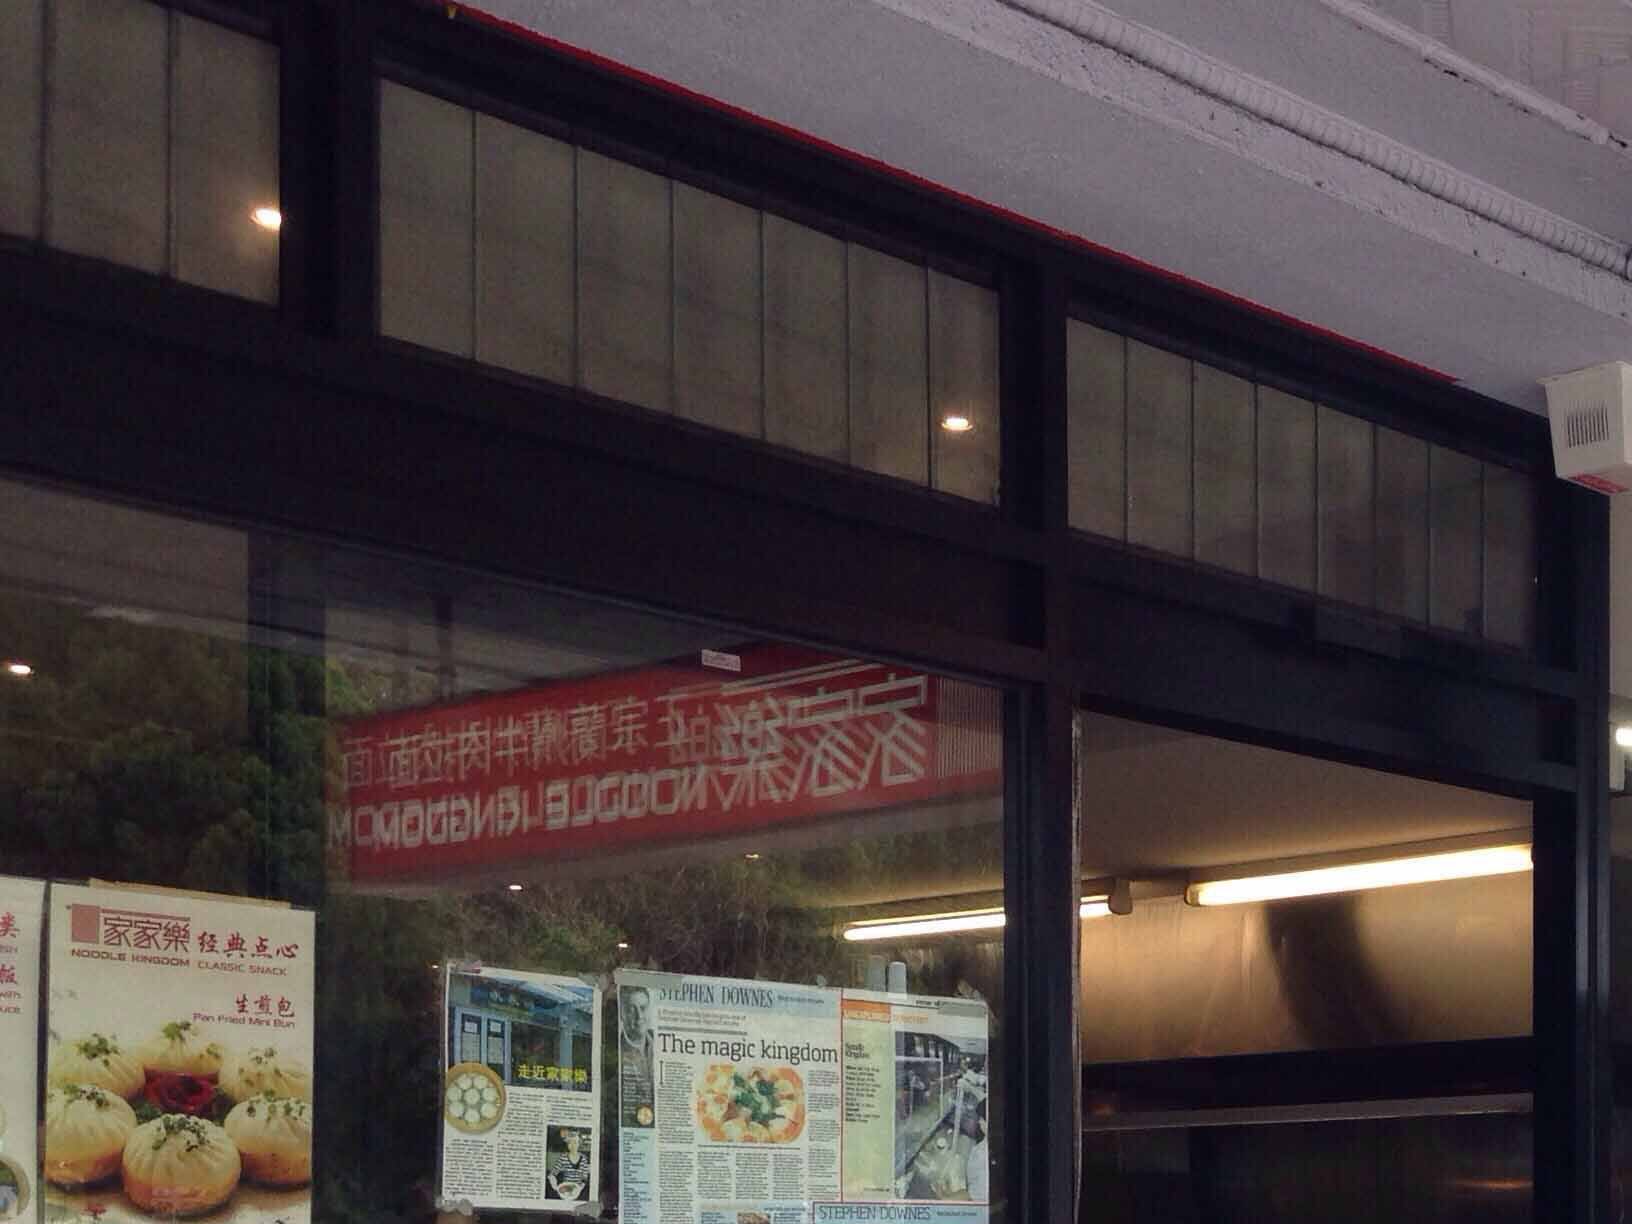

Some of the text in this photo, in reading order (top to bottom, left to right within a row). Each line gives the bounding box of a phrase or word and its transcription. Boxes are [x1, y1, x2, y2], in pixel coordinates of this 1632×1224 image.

[71, 948, 287, 977] NOODLE KINGDOM CLASSIC SNACK
[721, 985, 774, 1009] DOWNES
[658, 1032, 696, 1055] The
[701, 1038, 756, 1062] magic
[761, 1039, 838, 1066] kingdom
[818, 1205, 876, 1220] STEPHEN
[880, 1206, 931, 1221] DOWNES
